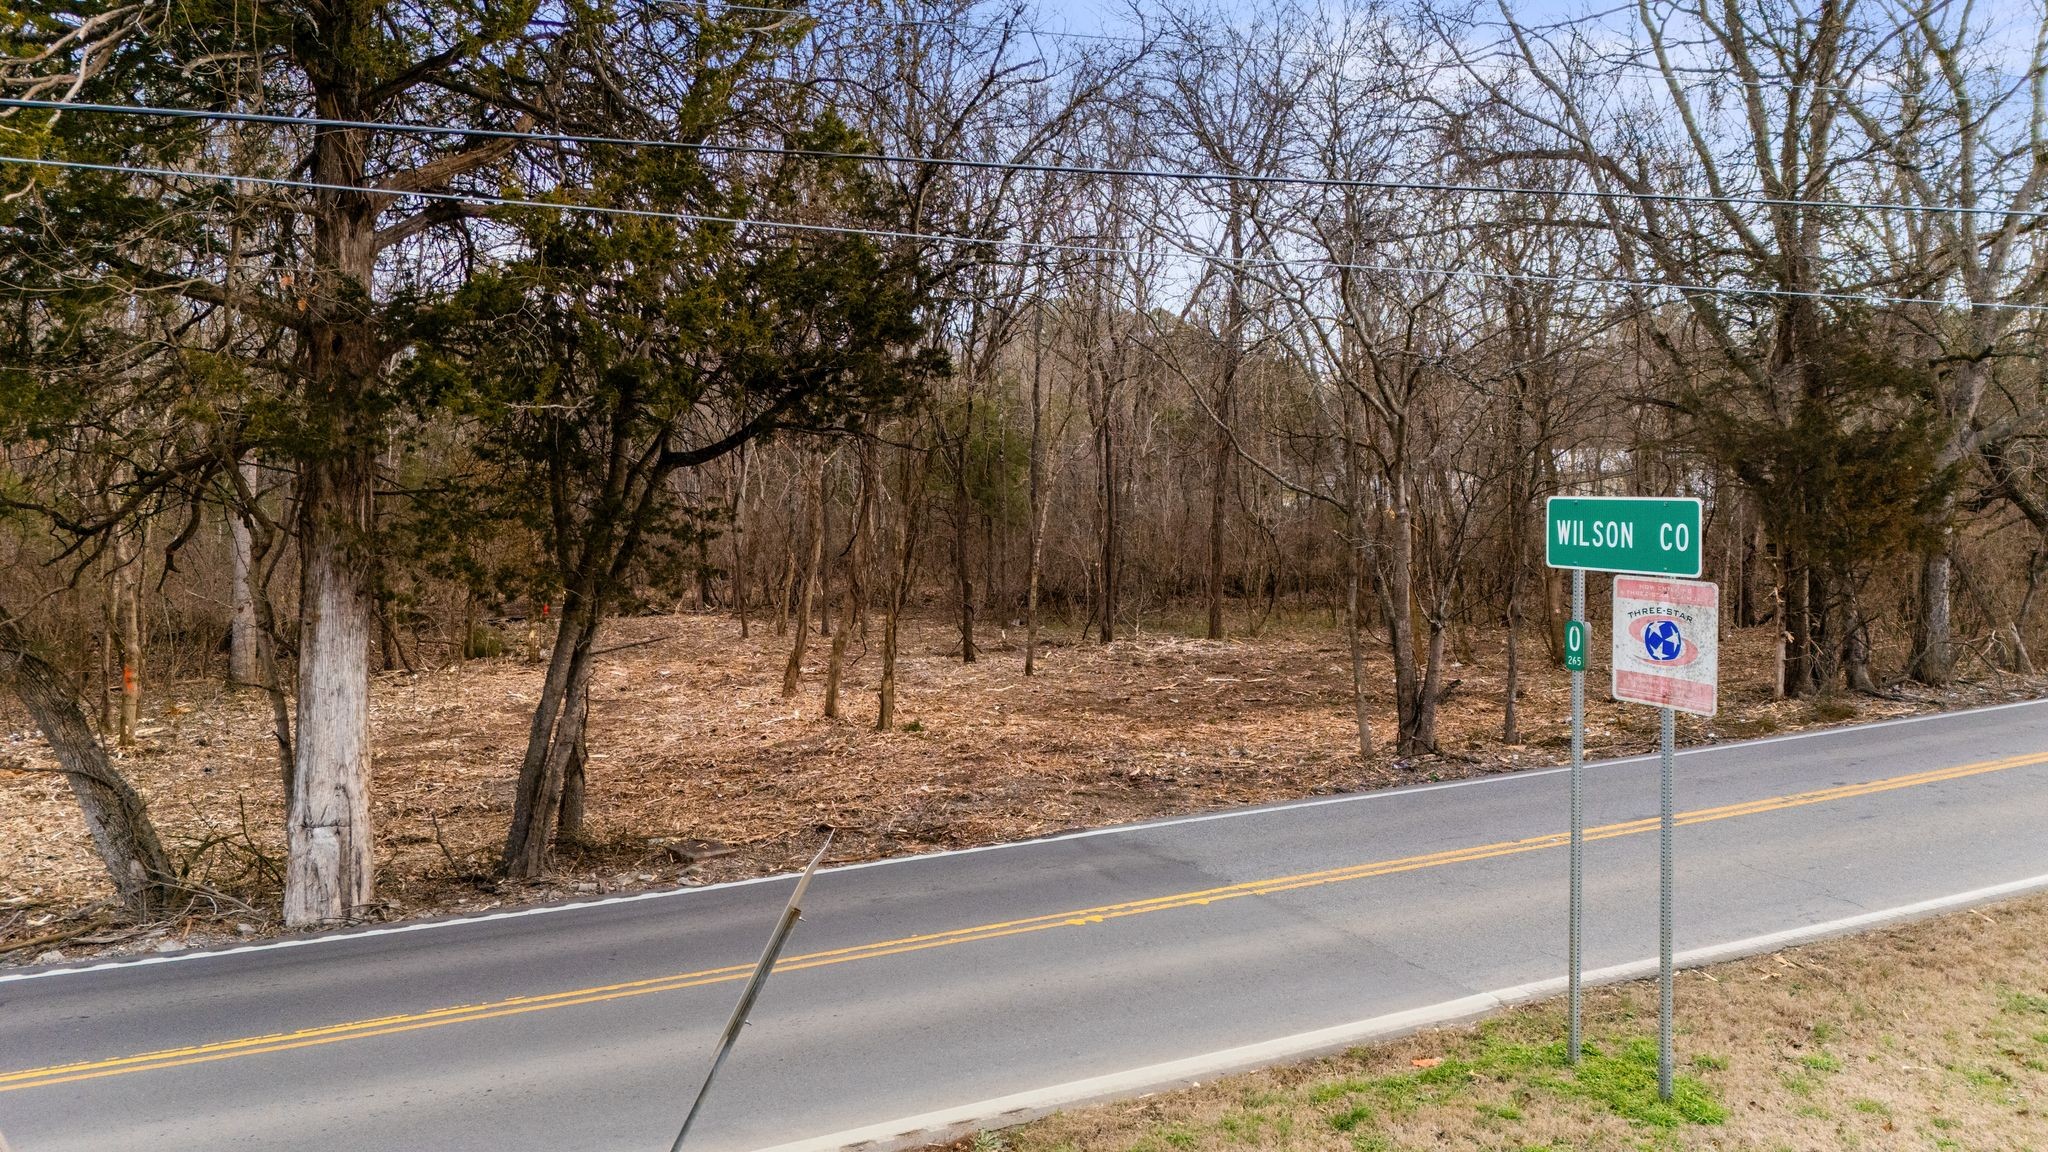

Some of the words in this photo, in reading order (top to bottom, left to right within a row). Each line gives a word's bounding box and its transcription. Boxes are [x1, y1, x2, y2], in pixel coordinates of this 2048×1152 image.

[1557, 519, 1633, 549] WILSON
[1659, 522, 1690, 552] CO
[1628, 607, 1693, 623] THREE-STAR
[1569, 625, 1580, 652] 0
[1567, 655, 1582, 666] 265
